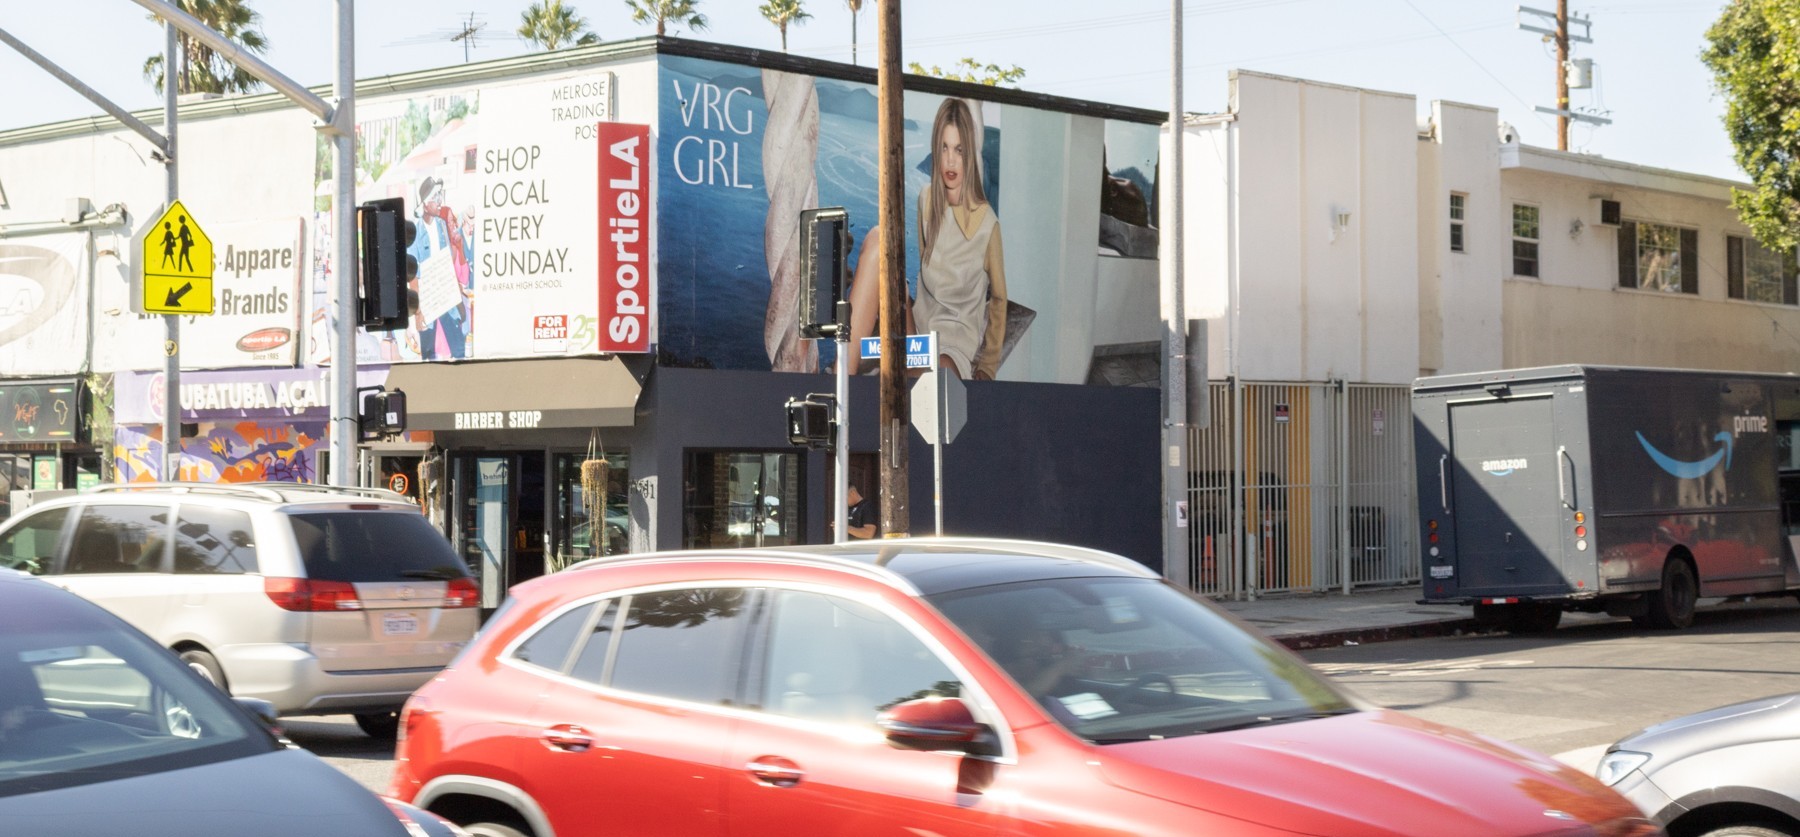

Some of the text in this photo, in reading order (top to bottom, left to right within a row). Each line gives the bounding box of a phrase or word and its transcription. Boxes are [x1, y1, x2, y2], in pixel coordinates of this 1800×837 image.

[552, 81, 605, 101] MELROSE
[552, 103, 605, 122] TRADING
[673, 80, 752, 134] VRG
[575, 124, 598, 140] POS
[485, 145, 541, 174] SHOP
[673, 136, 753, 189] GRL
[484, 179, 549, 208] LOCAL
[483, 214, 544, 243] EVERY
[609, 136, 645, 344] SportieLA
[224, 240, 296, 278] Appare
[482, 247, 572, 278] SUNDAY.
[489, 282, 514, 290] FAIRFAX
[516, 281, 533, 289] HIGH
[535, 280, 562, 289] SCHOOL
[221, 286, 288, 315] Brands
[535, 328, 567, 339] RENT
[538, 316, 563, 328] FOR
[252, 353, 266, 361] Since
[910, 339, 922, 352] Av
[180, 371, 327, 415] UBATUBA AÇAÍ
[454, 410, 542, 430] BARBER SHOP
[1733, 409, 1767, 438] prime
[1482, 458, 1527, 471] amazon
